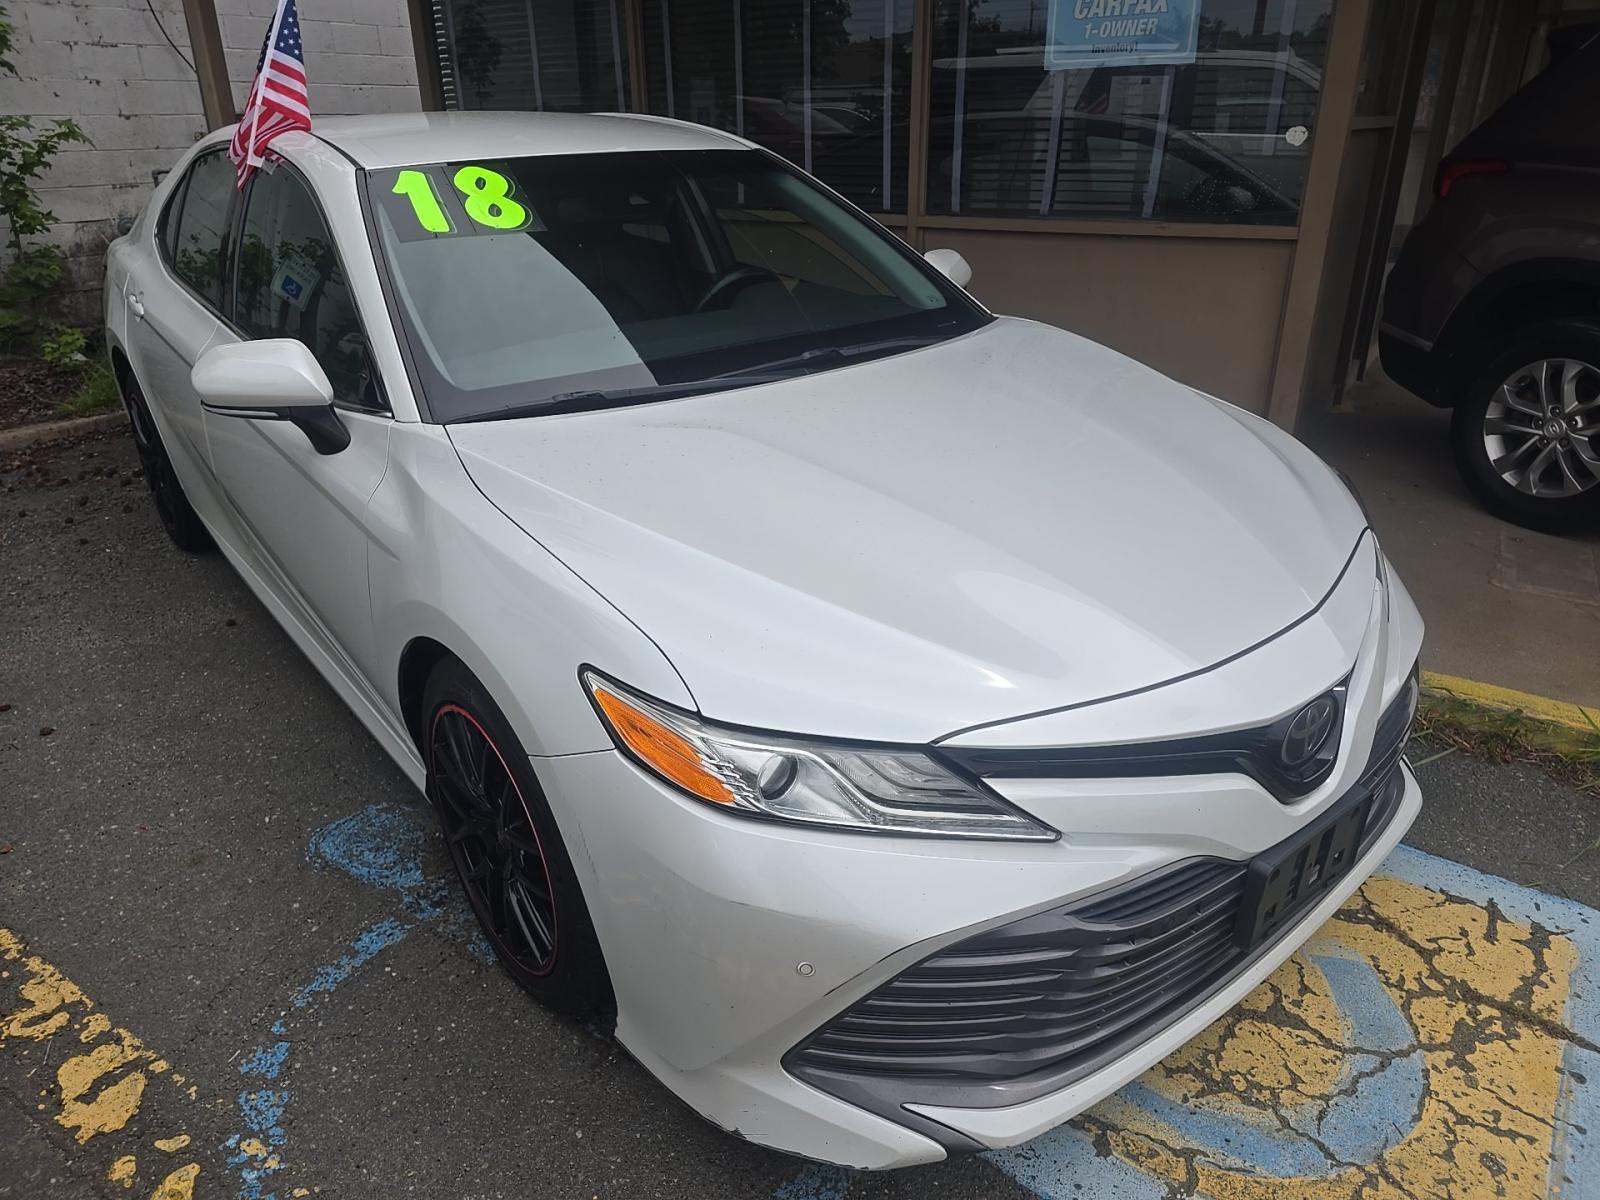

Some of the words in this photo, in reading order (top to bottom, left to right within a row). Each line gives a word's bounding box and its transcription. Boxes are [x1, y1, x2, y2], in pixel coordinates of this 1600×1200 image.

[1073, 0, 1168, 19] CARFAX
[1084, 18, 1159, 39] 1-OWNER
[392, 166, 527, 232] 18
